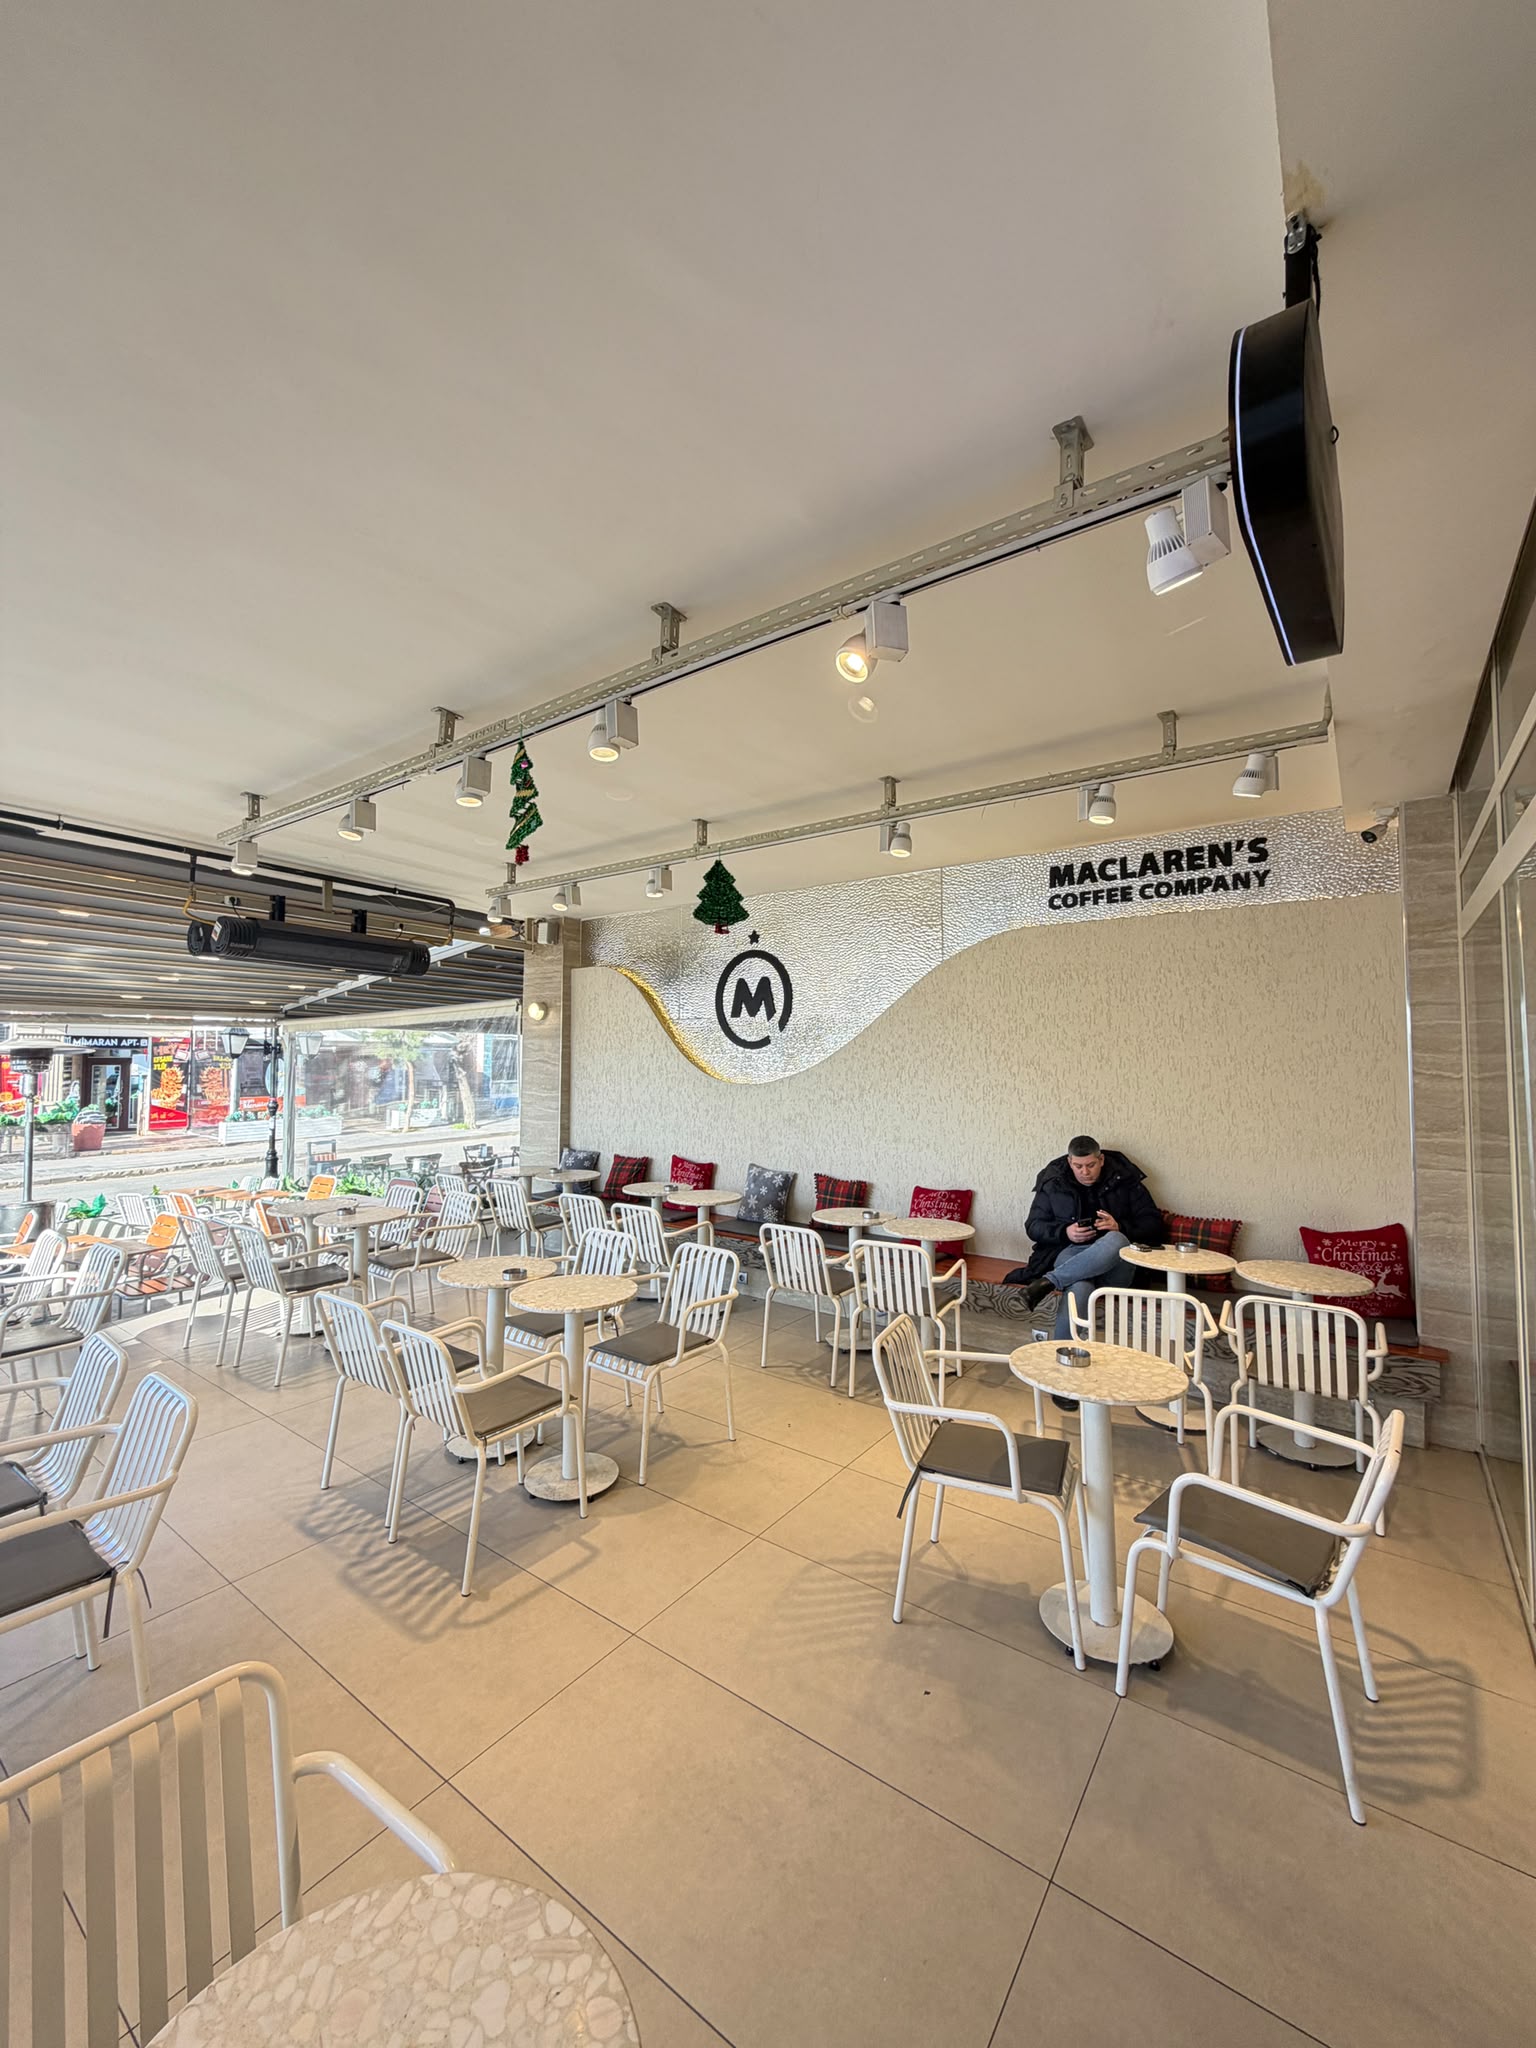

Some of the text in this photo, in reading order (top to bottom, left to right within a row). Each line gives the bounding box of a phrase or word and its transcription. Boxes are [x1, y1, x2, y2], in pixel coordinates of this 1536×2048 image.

[1049, 837, 1270, 889] MACLAREN'S
[1048, 869, 1271, 910] COFFEE COMPANY
[914, 1197, 959, 1211] Christmas
[1336, 1239, 1377, 1249] Merry
[1321, 1246, 1396, 1262] Christmas
